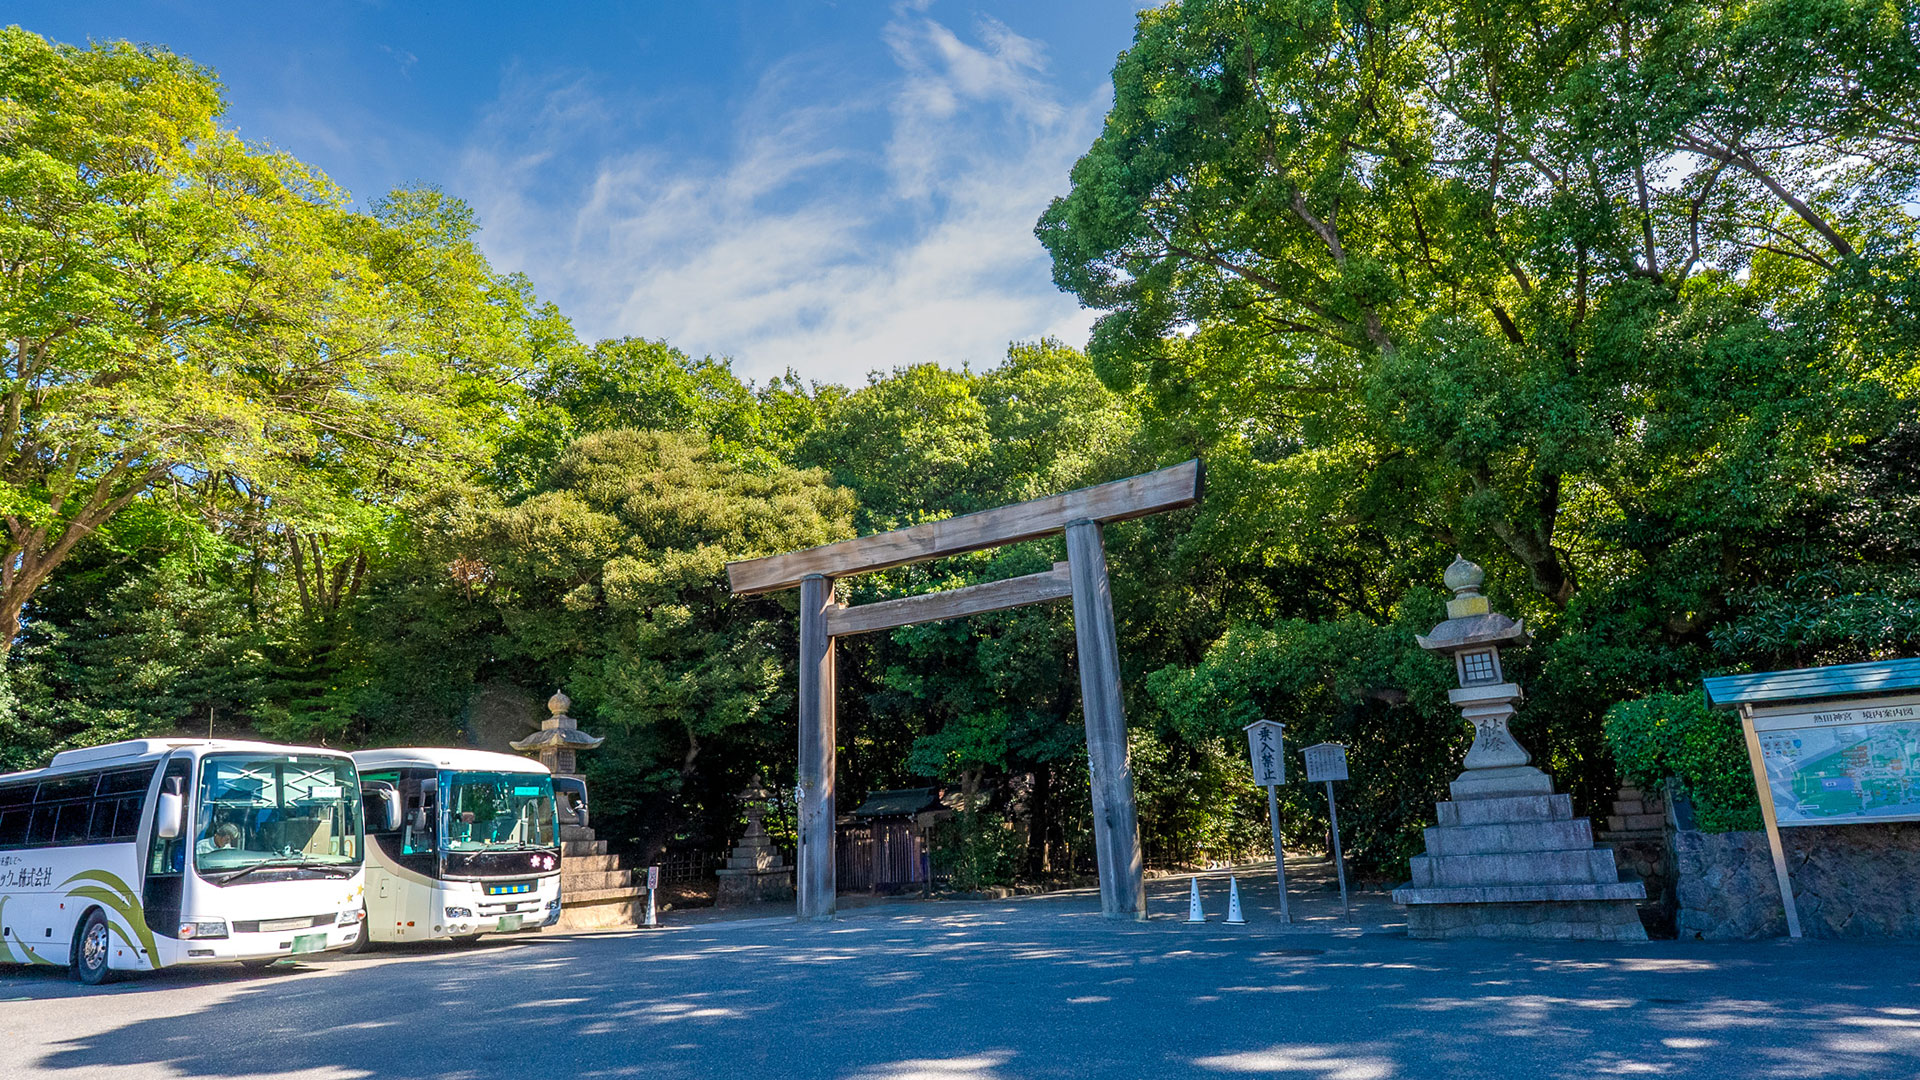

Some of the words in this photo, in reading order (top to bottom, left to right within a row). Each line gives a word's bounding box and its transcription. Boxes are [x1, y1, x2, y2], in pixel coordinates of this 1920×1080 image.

[1813, 711, 1852, 723] 熱田神宮
[1862, 707, 1914, 719] 境内案内図
[1257, 726, 1277, 780] 乗入禁止
